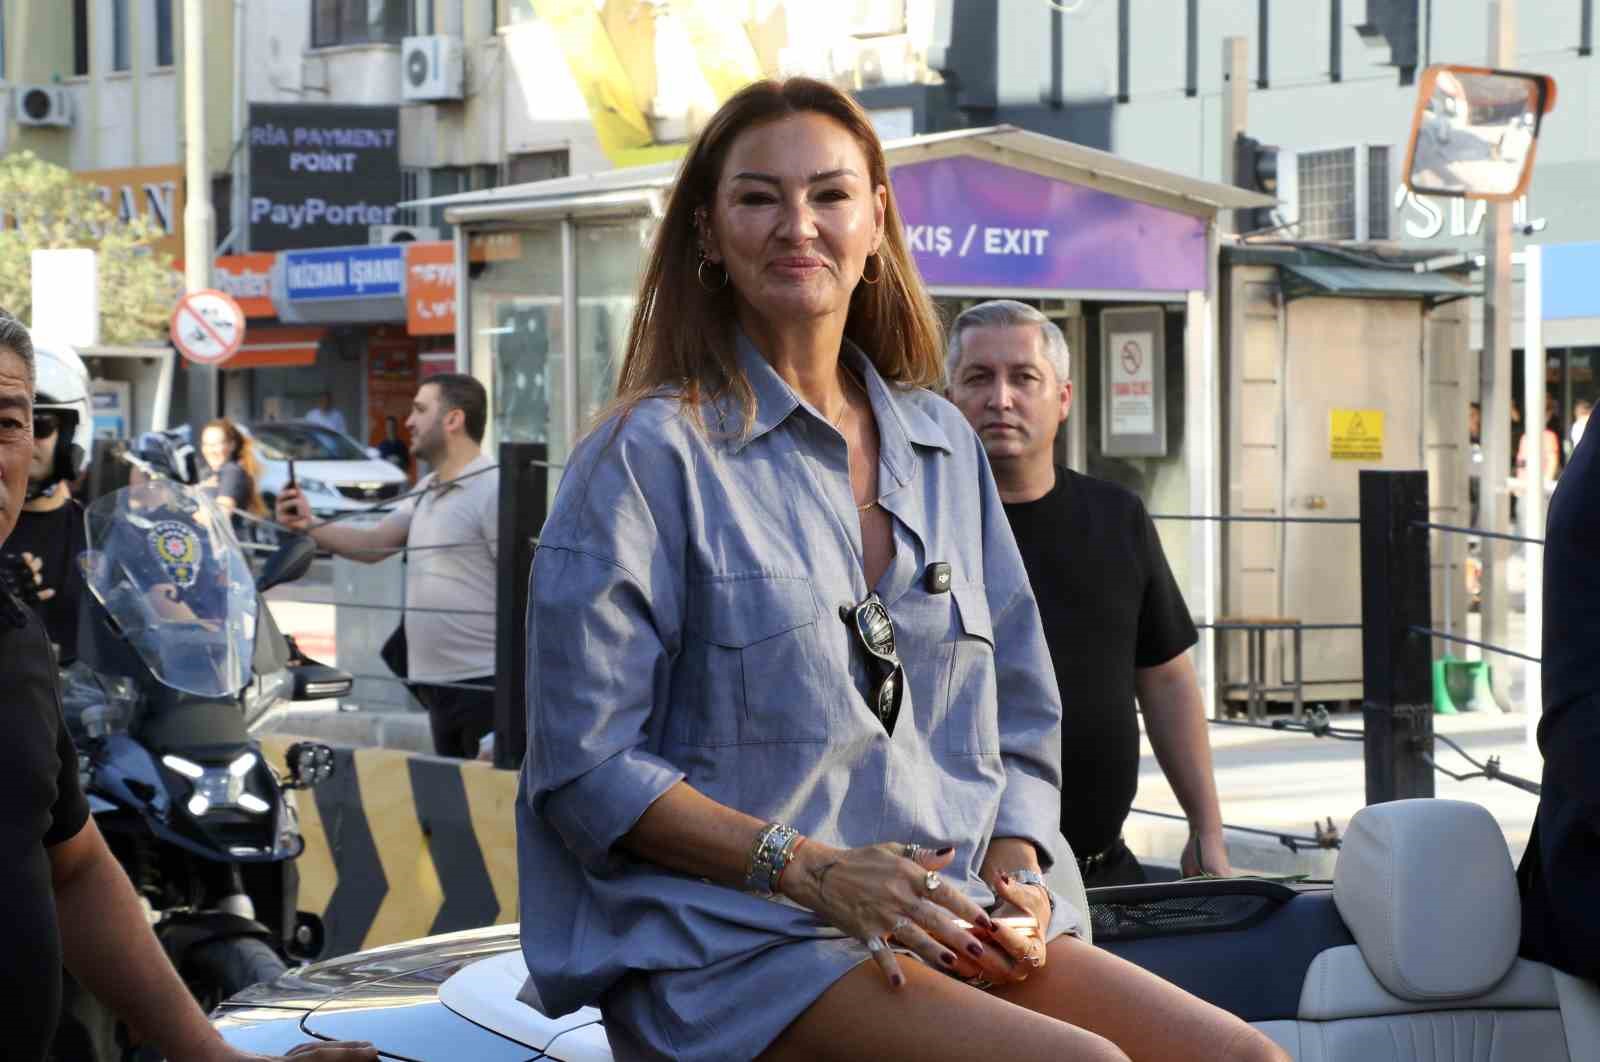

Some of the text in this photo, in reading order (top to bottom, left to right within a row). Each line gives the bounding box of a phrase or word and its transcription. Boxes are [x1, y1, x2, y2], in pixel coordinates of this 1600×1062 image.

[293, 127, 395, 147] PAYMENT
[250, 198, 396, 229] PayPorter
[906, 224, 1049, 256] KIŞ / EXIT
